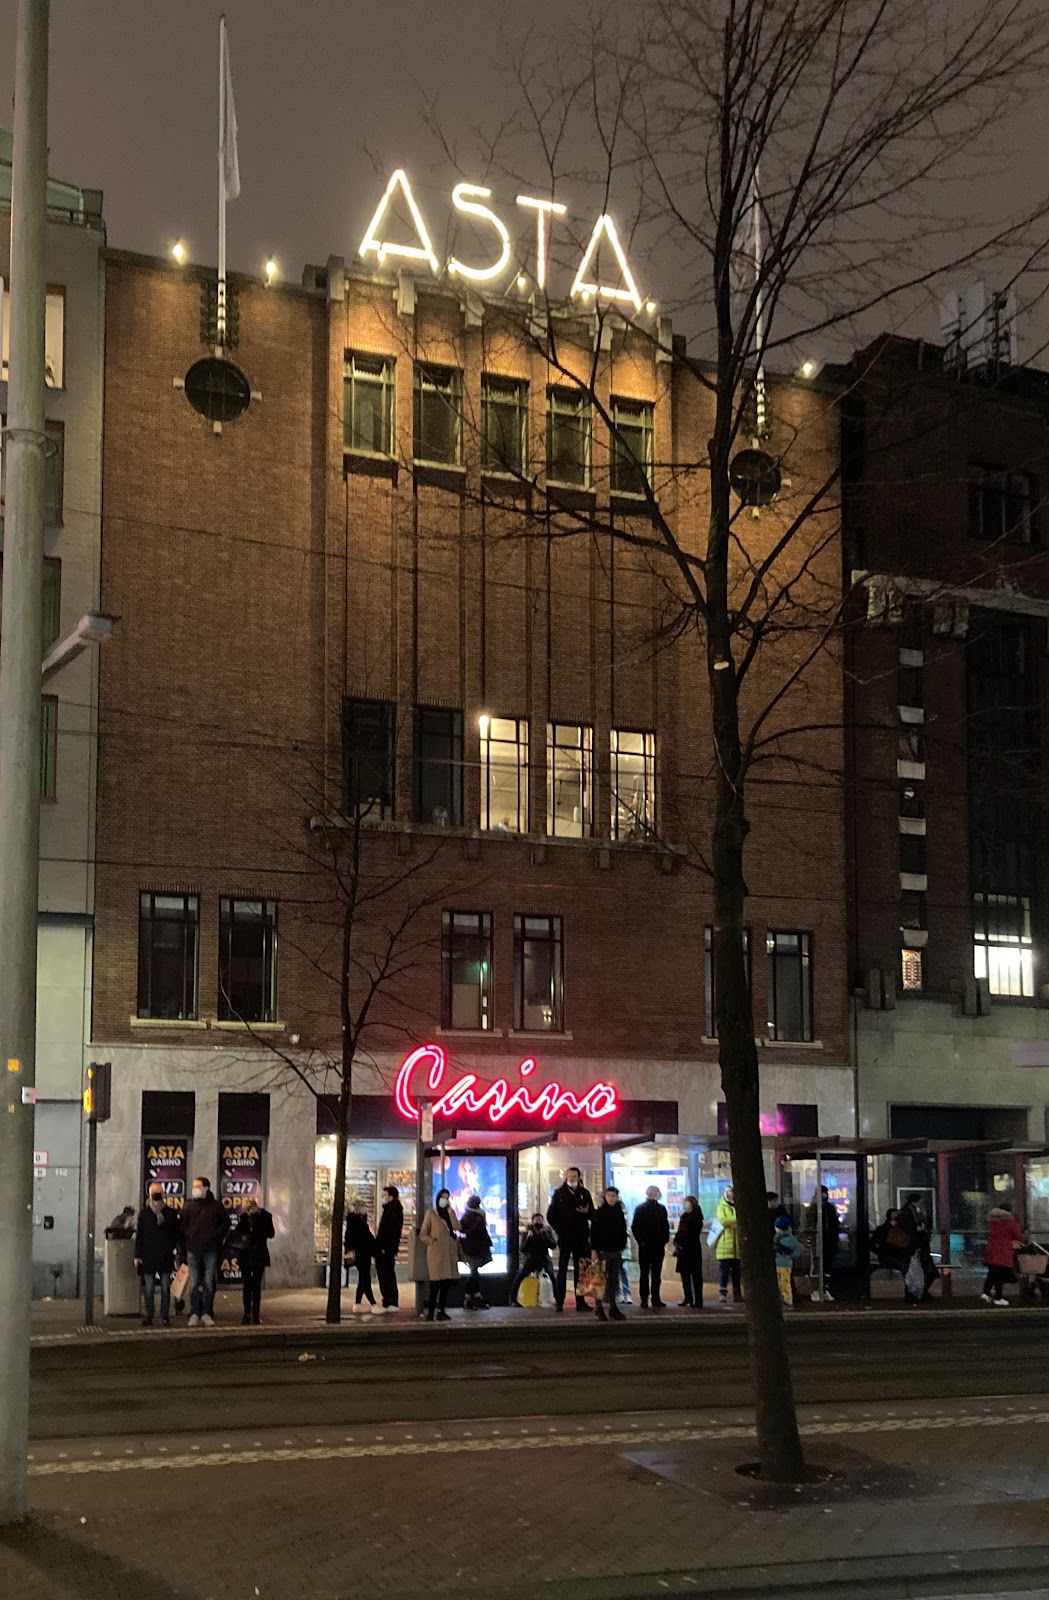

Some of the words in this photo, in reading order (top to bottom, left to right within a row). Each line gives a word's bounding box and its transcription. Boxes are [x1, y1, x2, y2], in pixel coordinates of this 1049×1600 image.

[359, 168, 642, 312] ASTA
[395, 1045, 617, 1121] Casino
[147, 1145, 185, 1159] ASTA
[223, 1146, 260, 1159] ASTA
[226, 1181, 254, 1194] 24/7
[221, 1197, 254, 1209] OPE
[220, 1257, 241, 1271] AS
